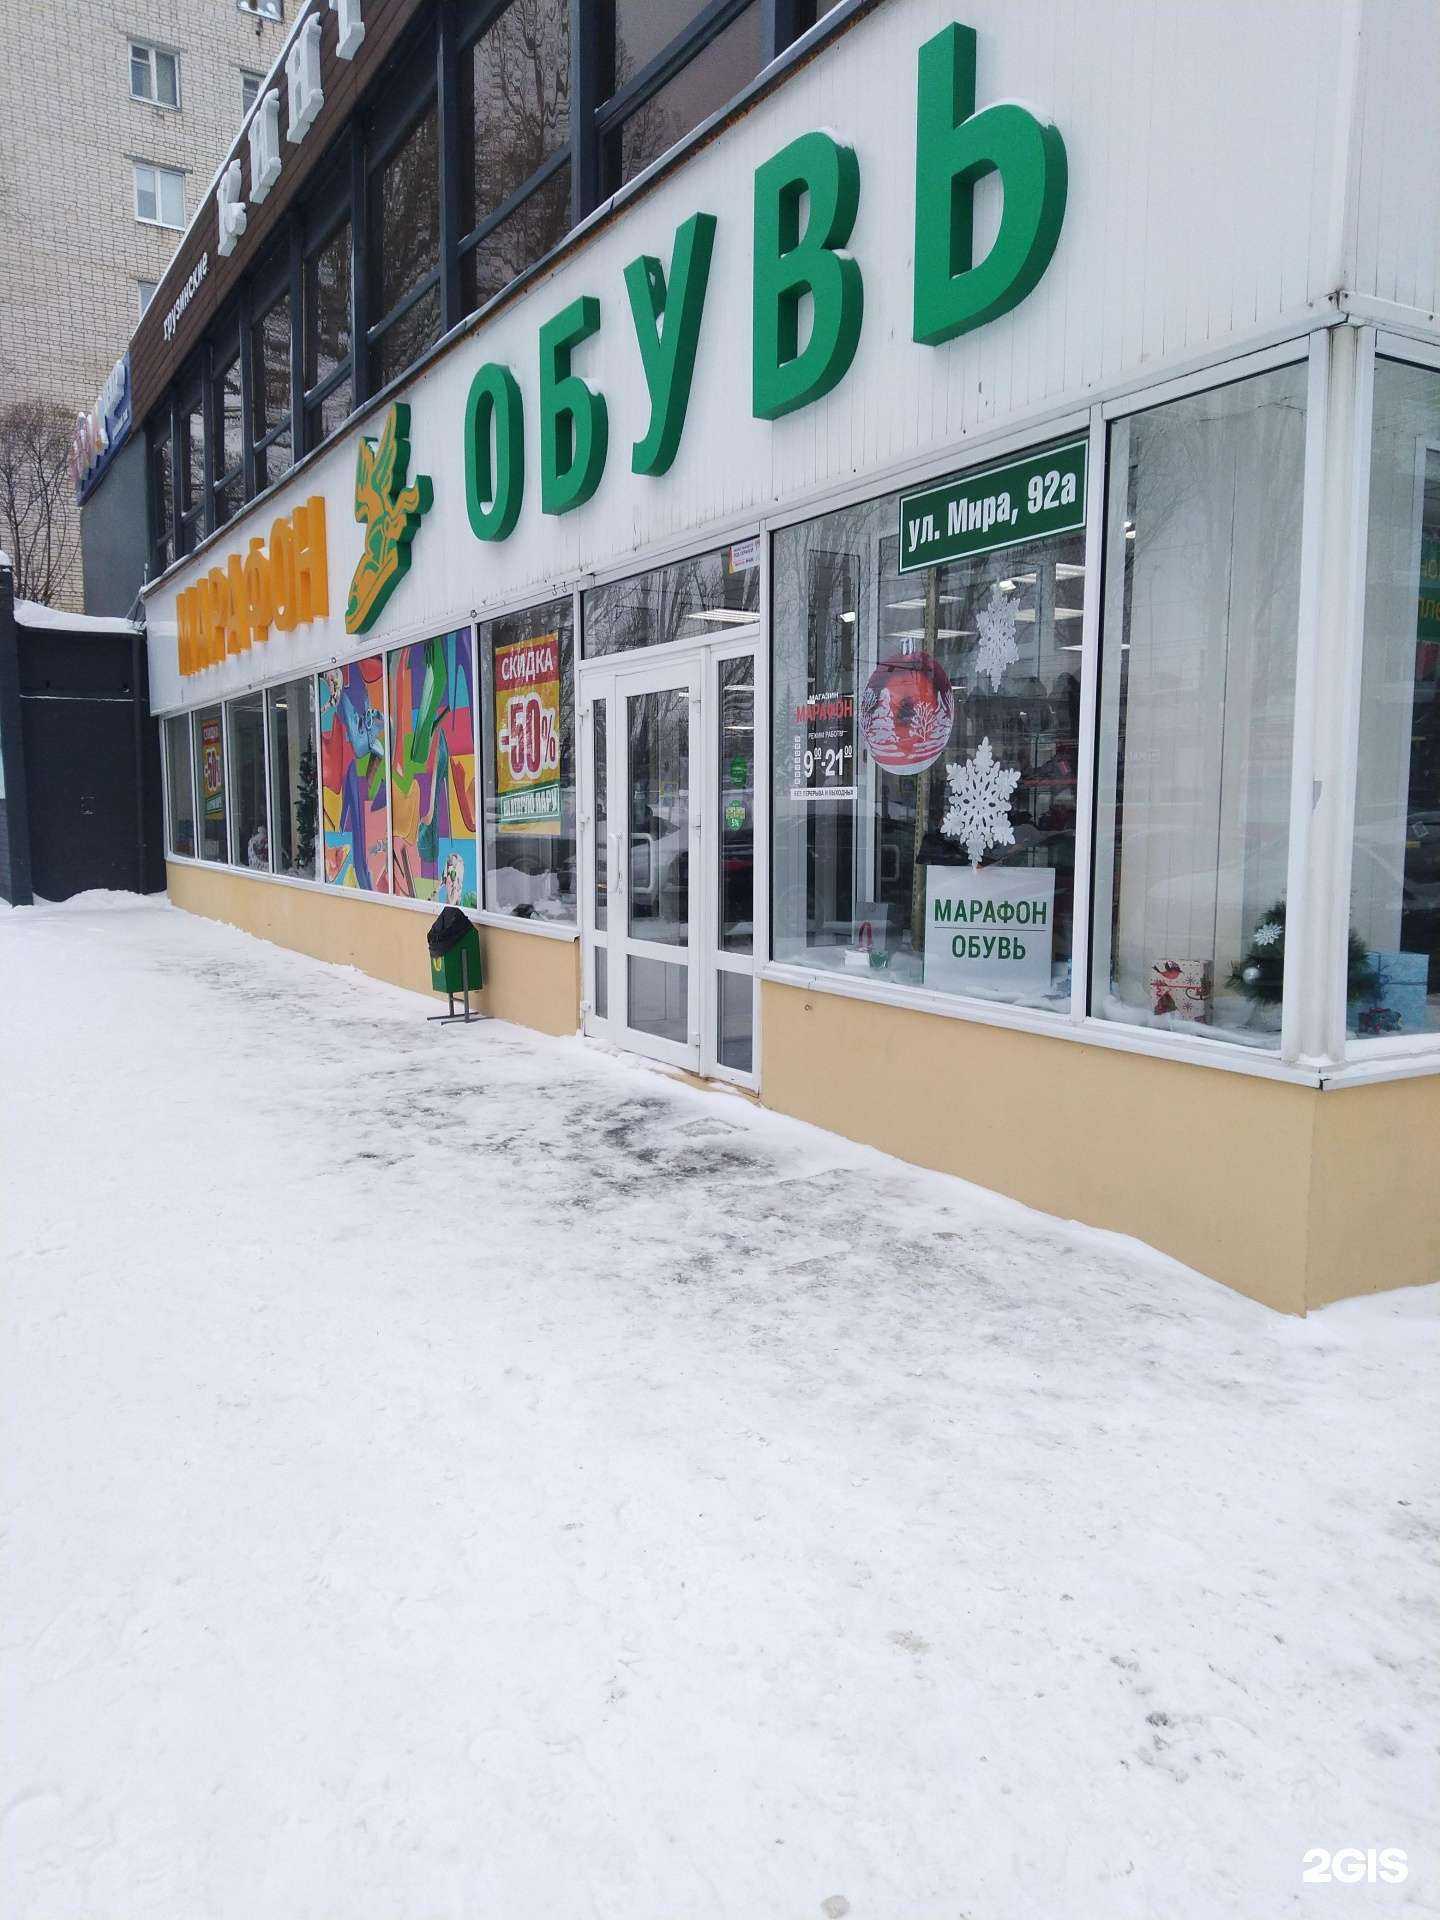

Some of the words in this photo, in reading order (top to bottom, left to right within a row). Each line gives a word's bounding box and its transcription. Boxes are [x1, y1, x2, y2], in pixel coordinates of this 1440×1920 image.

[464, 21, 1069, 543] ОБУВЬ
[908, 514, 941, 553] ул.
[947, 491, 1019, 537] Мира,
[1027, 470, 1077, 514] 92а
[176, 495, 330, 677] МАРАФОН
[501, 647, 554, 683] СКИДКА
[499, 696, 558, 775] -50%
[934, 898, 1047, 925] МАРАФОН
[951, 934, 1026, 960] ОБУВЬ
